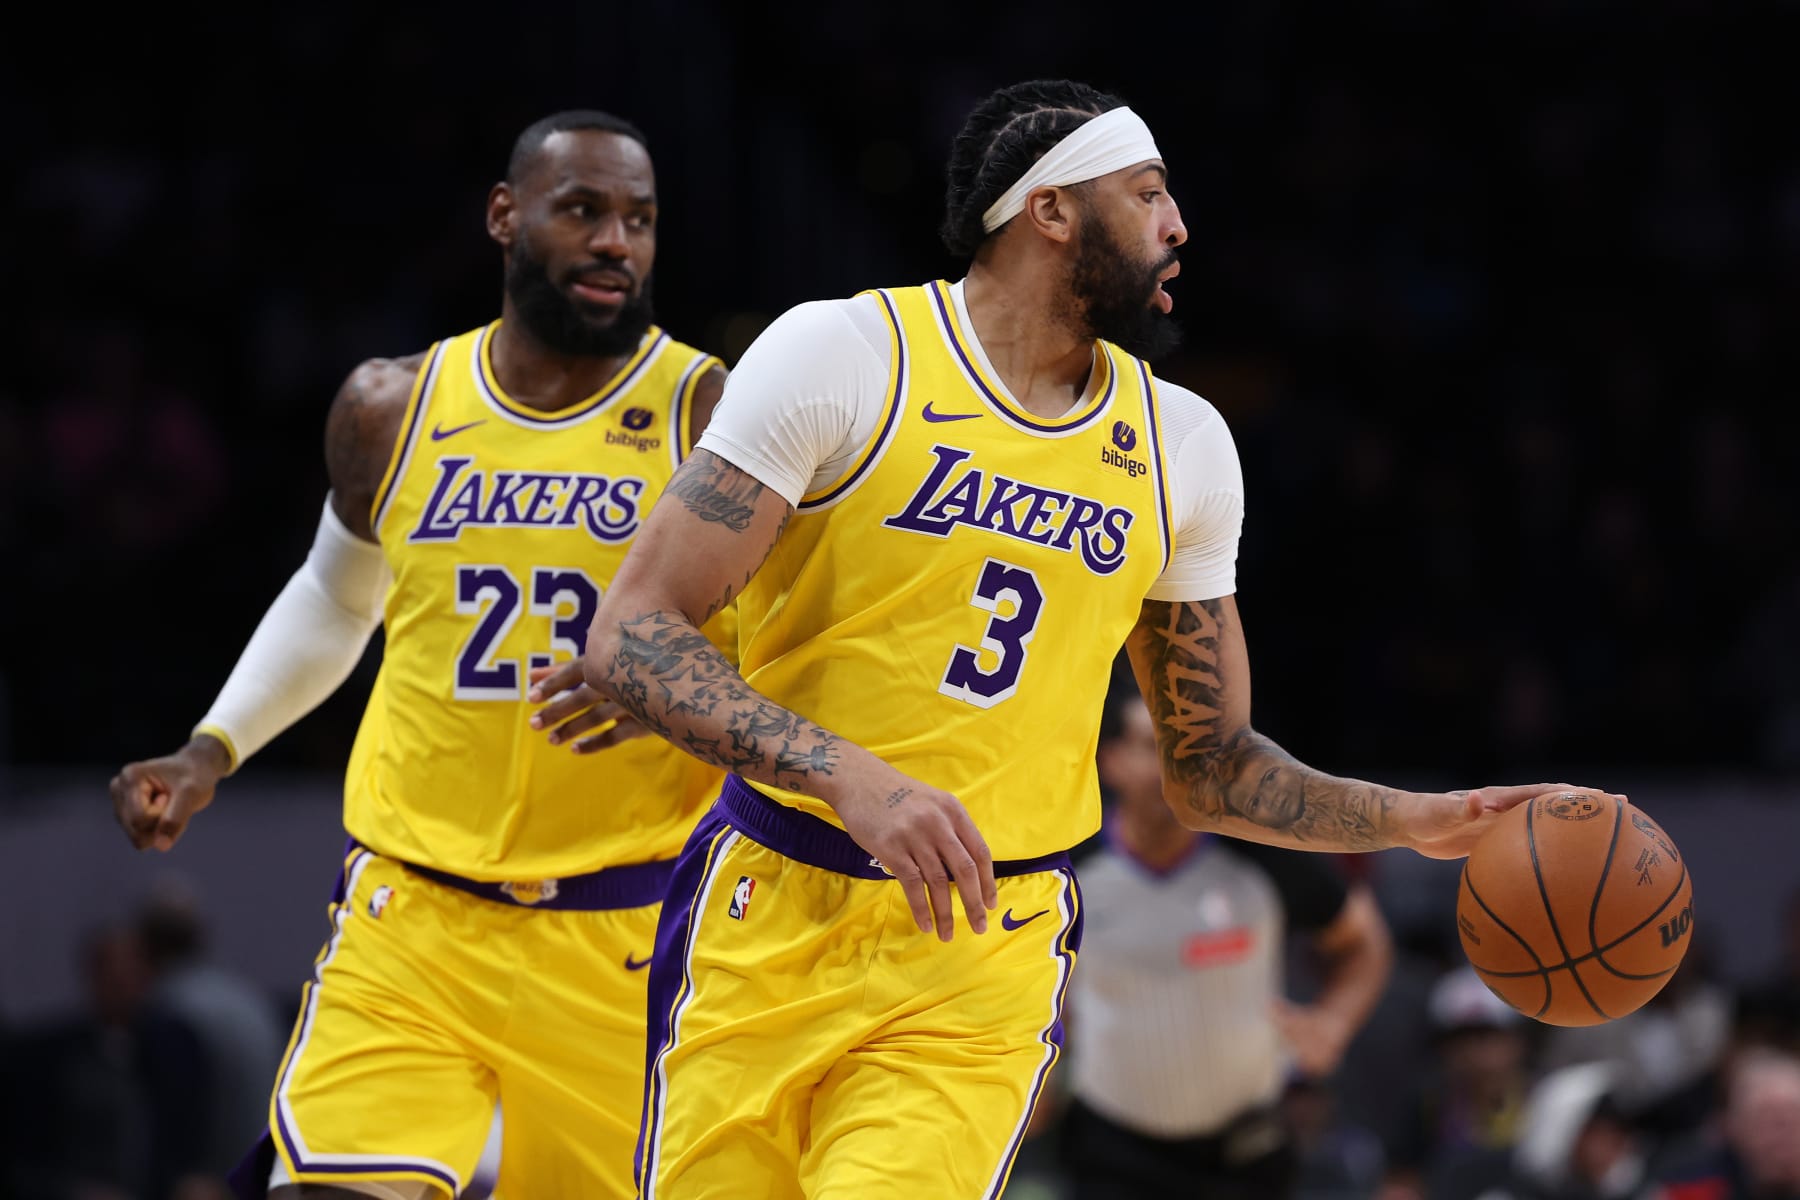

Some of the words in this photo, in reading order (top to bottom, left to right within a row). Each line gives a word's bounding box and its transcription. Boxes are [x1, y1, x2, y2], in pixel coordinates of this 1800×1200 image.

[605, 430, 660, 453] bibigo
[1101, 446, 1147, 478] bibigo
[407, 455, 646, 545] LAKERS
[880, 443, 1137, 577] LAKERS
[453, 564, 600, 701] 23
[937, 556, 1046, 710] 3
